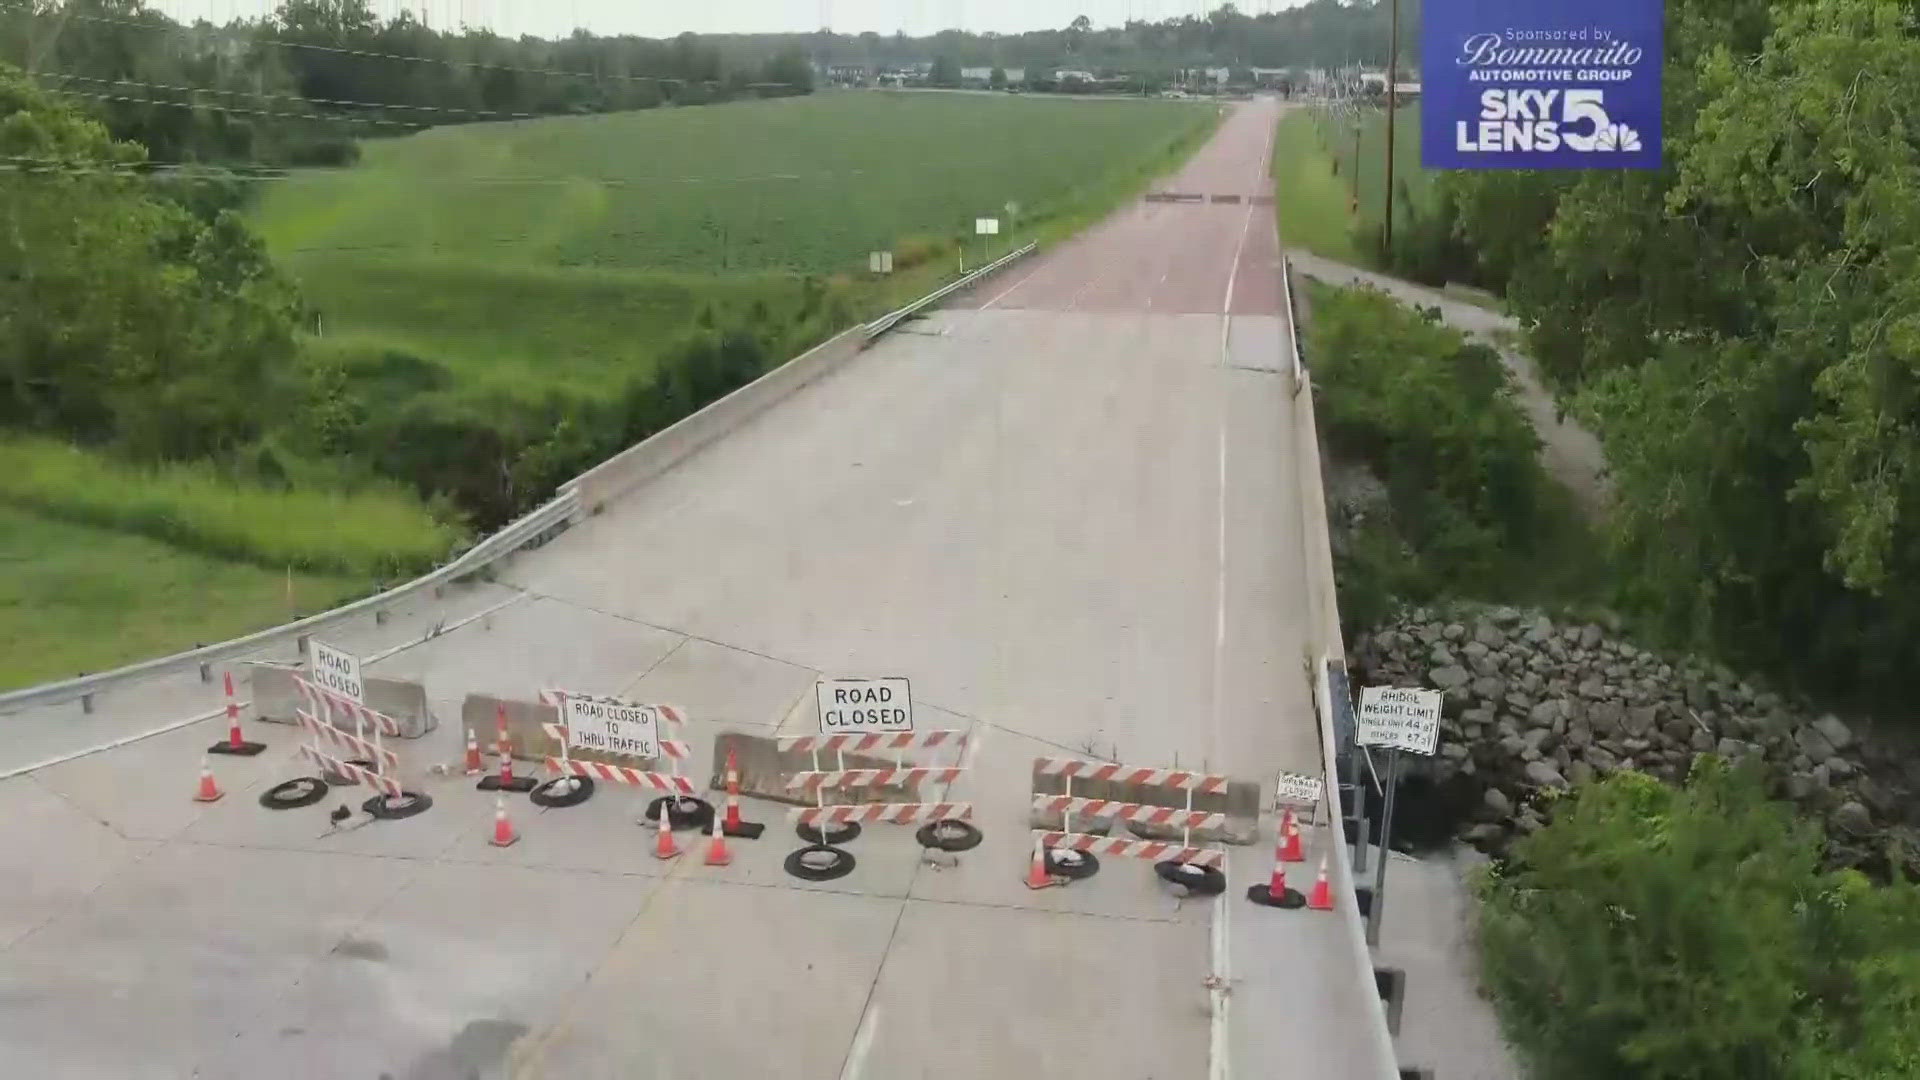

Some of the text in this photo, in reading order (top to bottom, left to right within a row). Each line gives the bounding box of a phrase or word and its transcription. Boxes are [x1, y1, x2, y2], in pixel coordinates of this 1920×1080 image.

[319, 650, 351, 675] ROAD
[315, 669, 360, 697] CLOSED
[835, 687, 892, 704] ROAD
[575, 703, 649, 724] ROAD CLOSED
[826, 708, 906, 726] CLOSED
[1364, 703, 1434, 719] WEIGHT LIMIT
[606, 721, 619, 734] TO
[578, 731, 651, 754] THRU TRAFFIC
